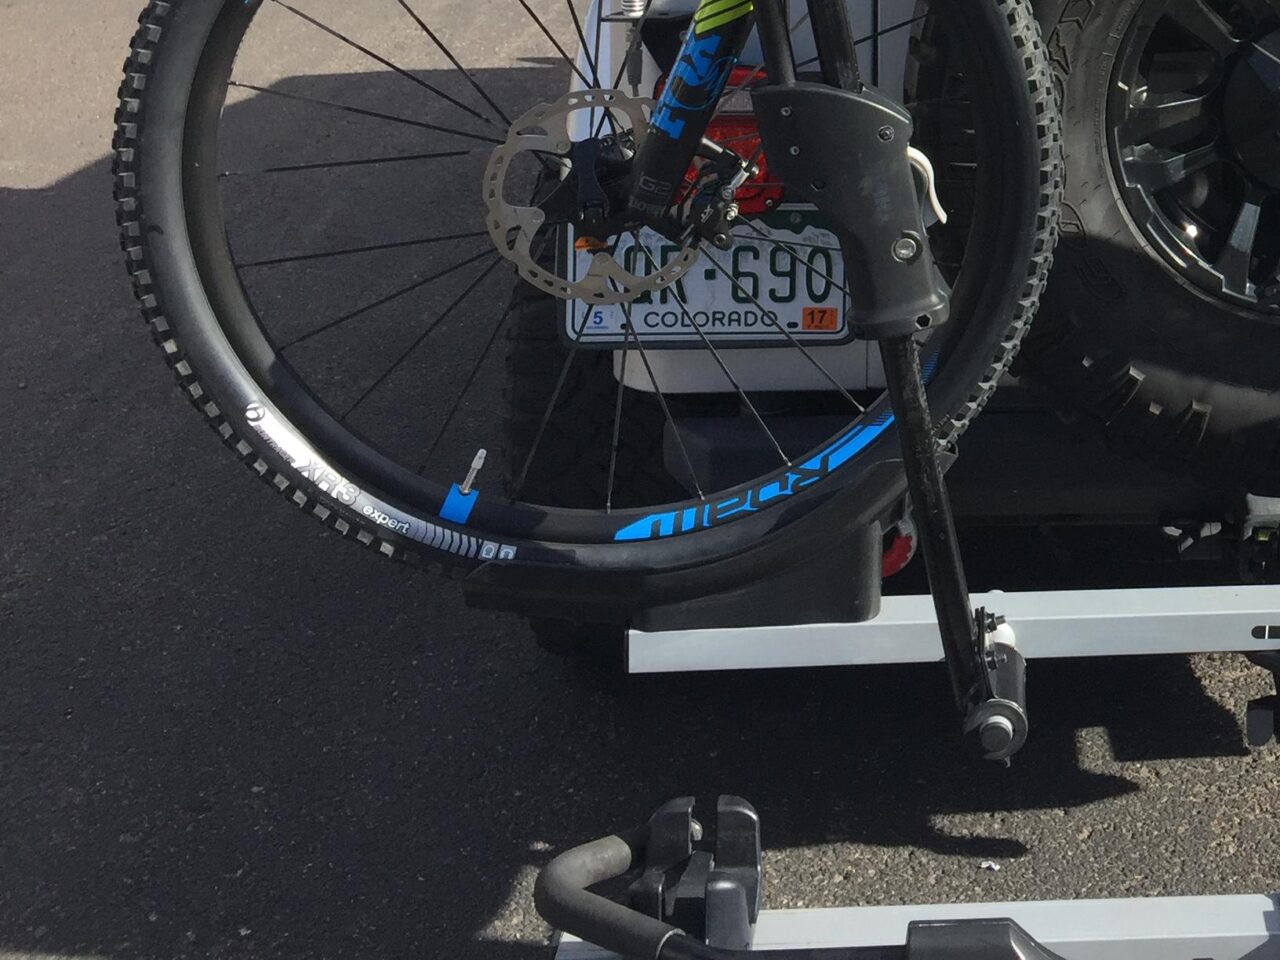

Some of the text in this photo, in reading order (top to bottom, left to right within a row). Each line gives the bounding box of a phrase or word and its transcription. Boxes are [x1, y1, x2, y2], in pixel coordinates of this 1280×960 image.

[650, 34, 724, 139] FOX
[592, 311, 604, 325] 5
[643, 311, 778, 328] COLORADO
[807, 309, 827, 325] 17
[299, 457, 362, 506] XR3
[362, 504, 411, 535] expert
